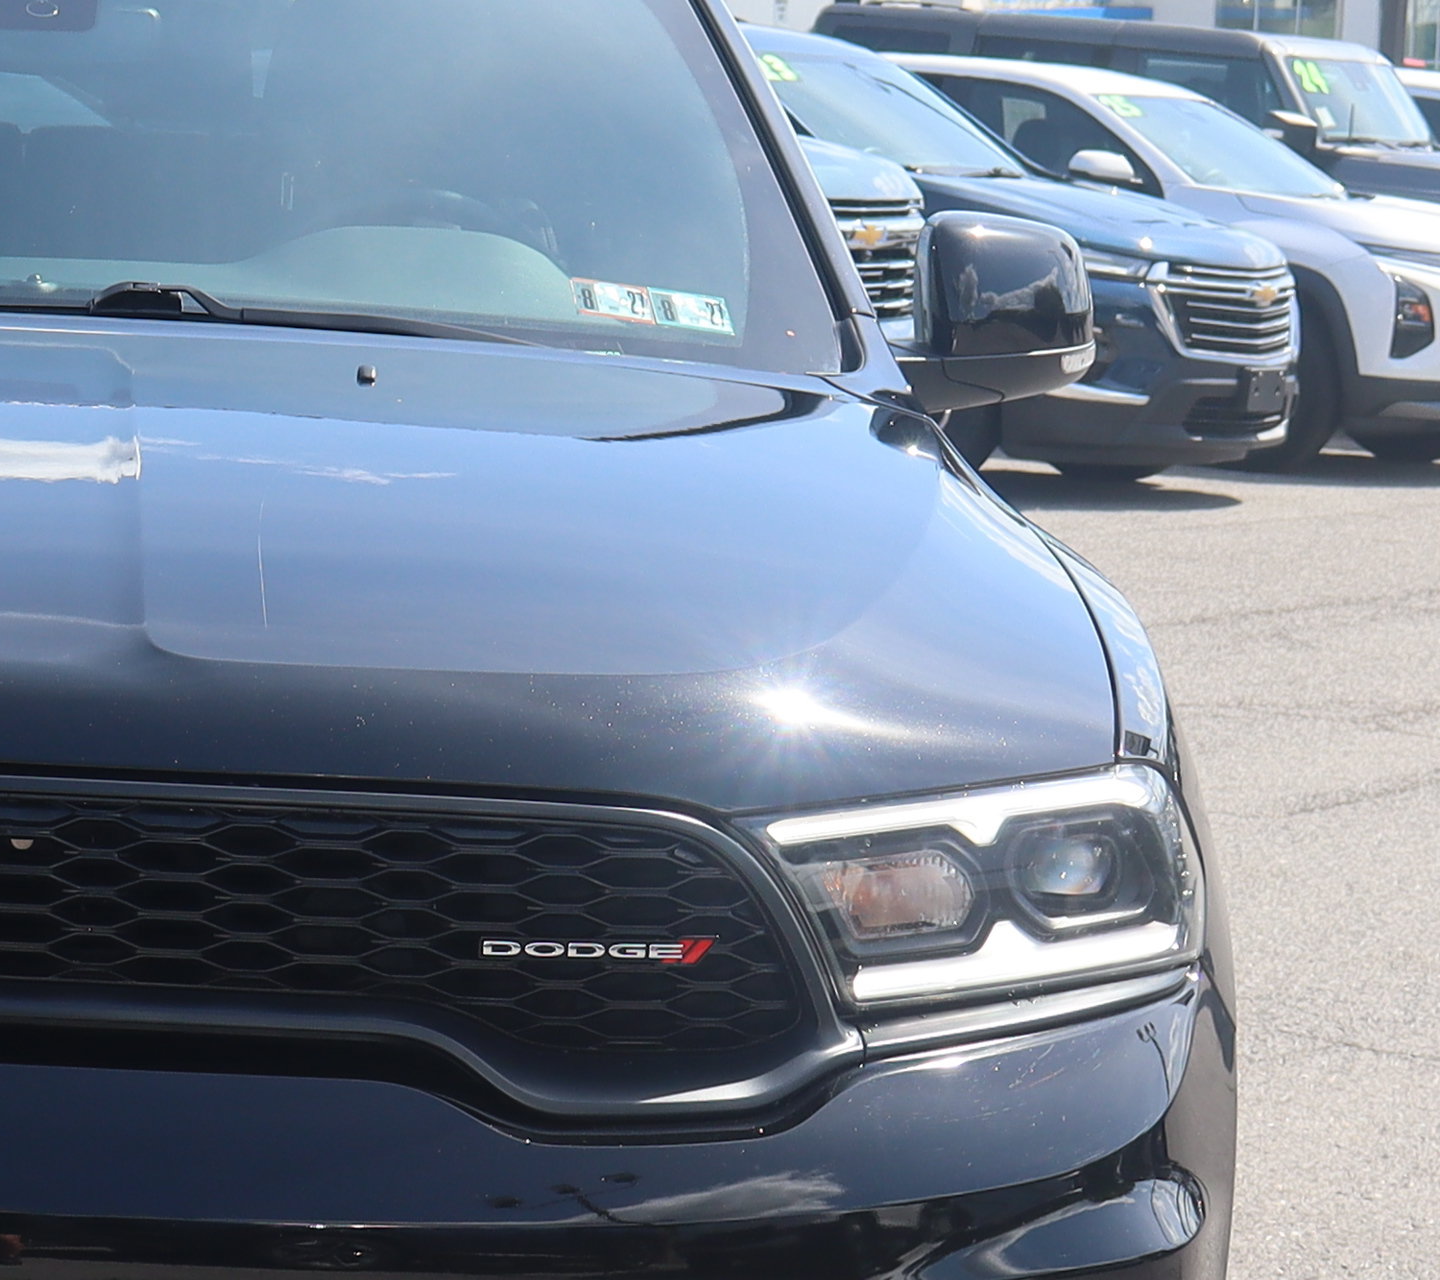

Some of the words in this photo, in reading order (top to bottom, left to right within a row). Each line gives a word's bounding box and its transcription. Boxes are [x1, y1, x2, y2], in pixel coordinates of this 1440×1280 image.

[627, 290, 645, 317] 27
[705, 301, 725, 327] 27
[482, 940, 684, 959] DODGE
